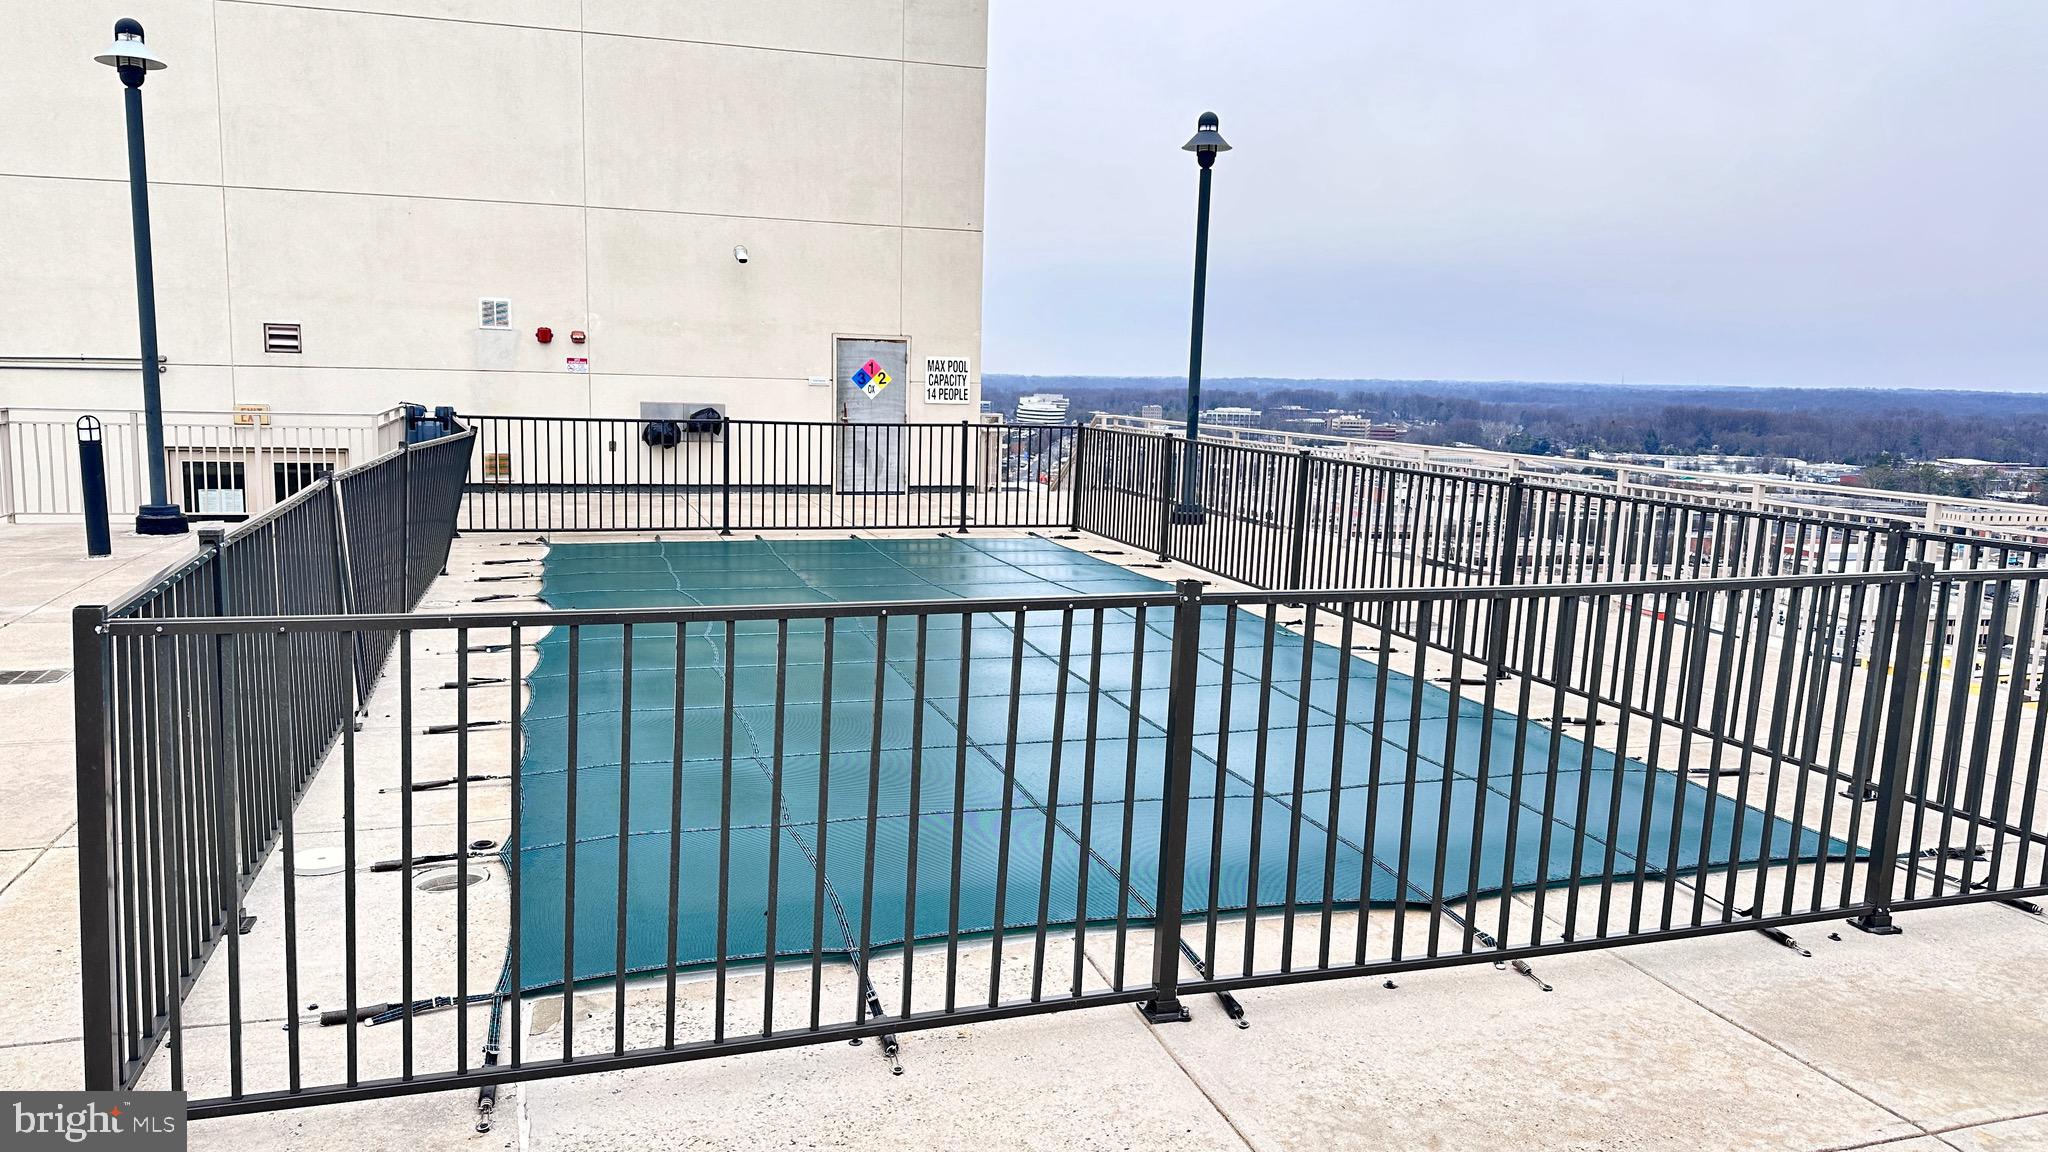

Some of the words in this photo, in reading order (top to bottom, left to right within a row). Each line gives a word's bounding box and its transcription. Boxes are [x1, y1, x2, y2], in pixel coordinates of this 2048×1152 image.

[868, 362, 874, 375] 1
[927, 359, 946, 373] MAX
[947, 360, 968, 373] POOL
[858, 372, 867, 385] 3
[877, 371, 887, 385] 2
[928, 374, 967, 387] CAPACITY
[926, 387, 936, 401] 14
[938, 388, 969, 401] PEOPLE
